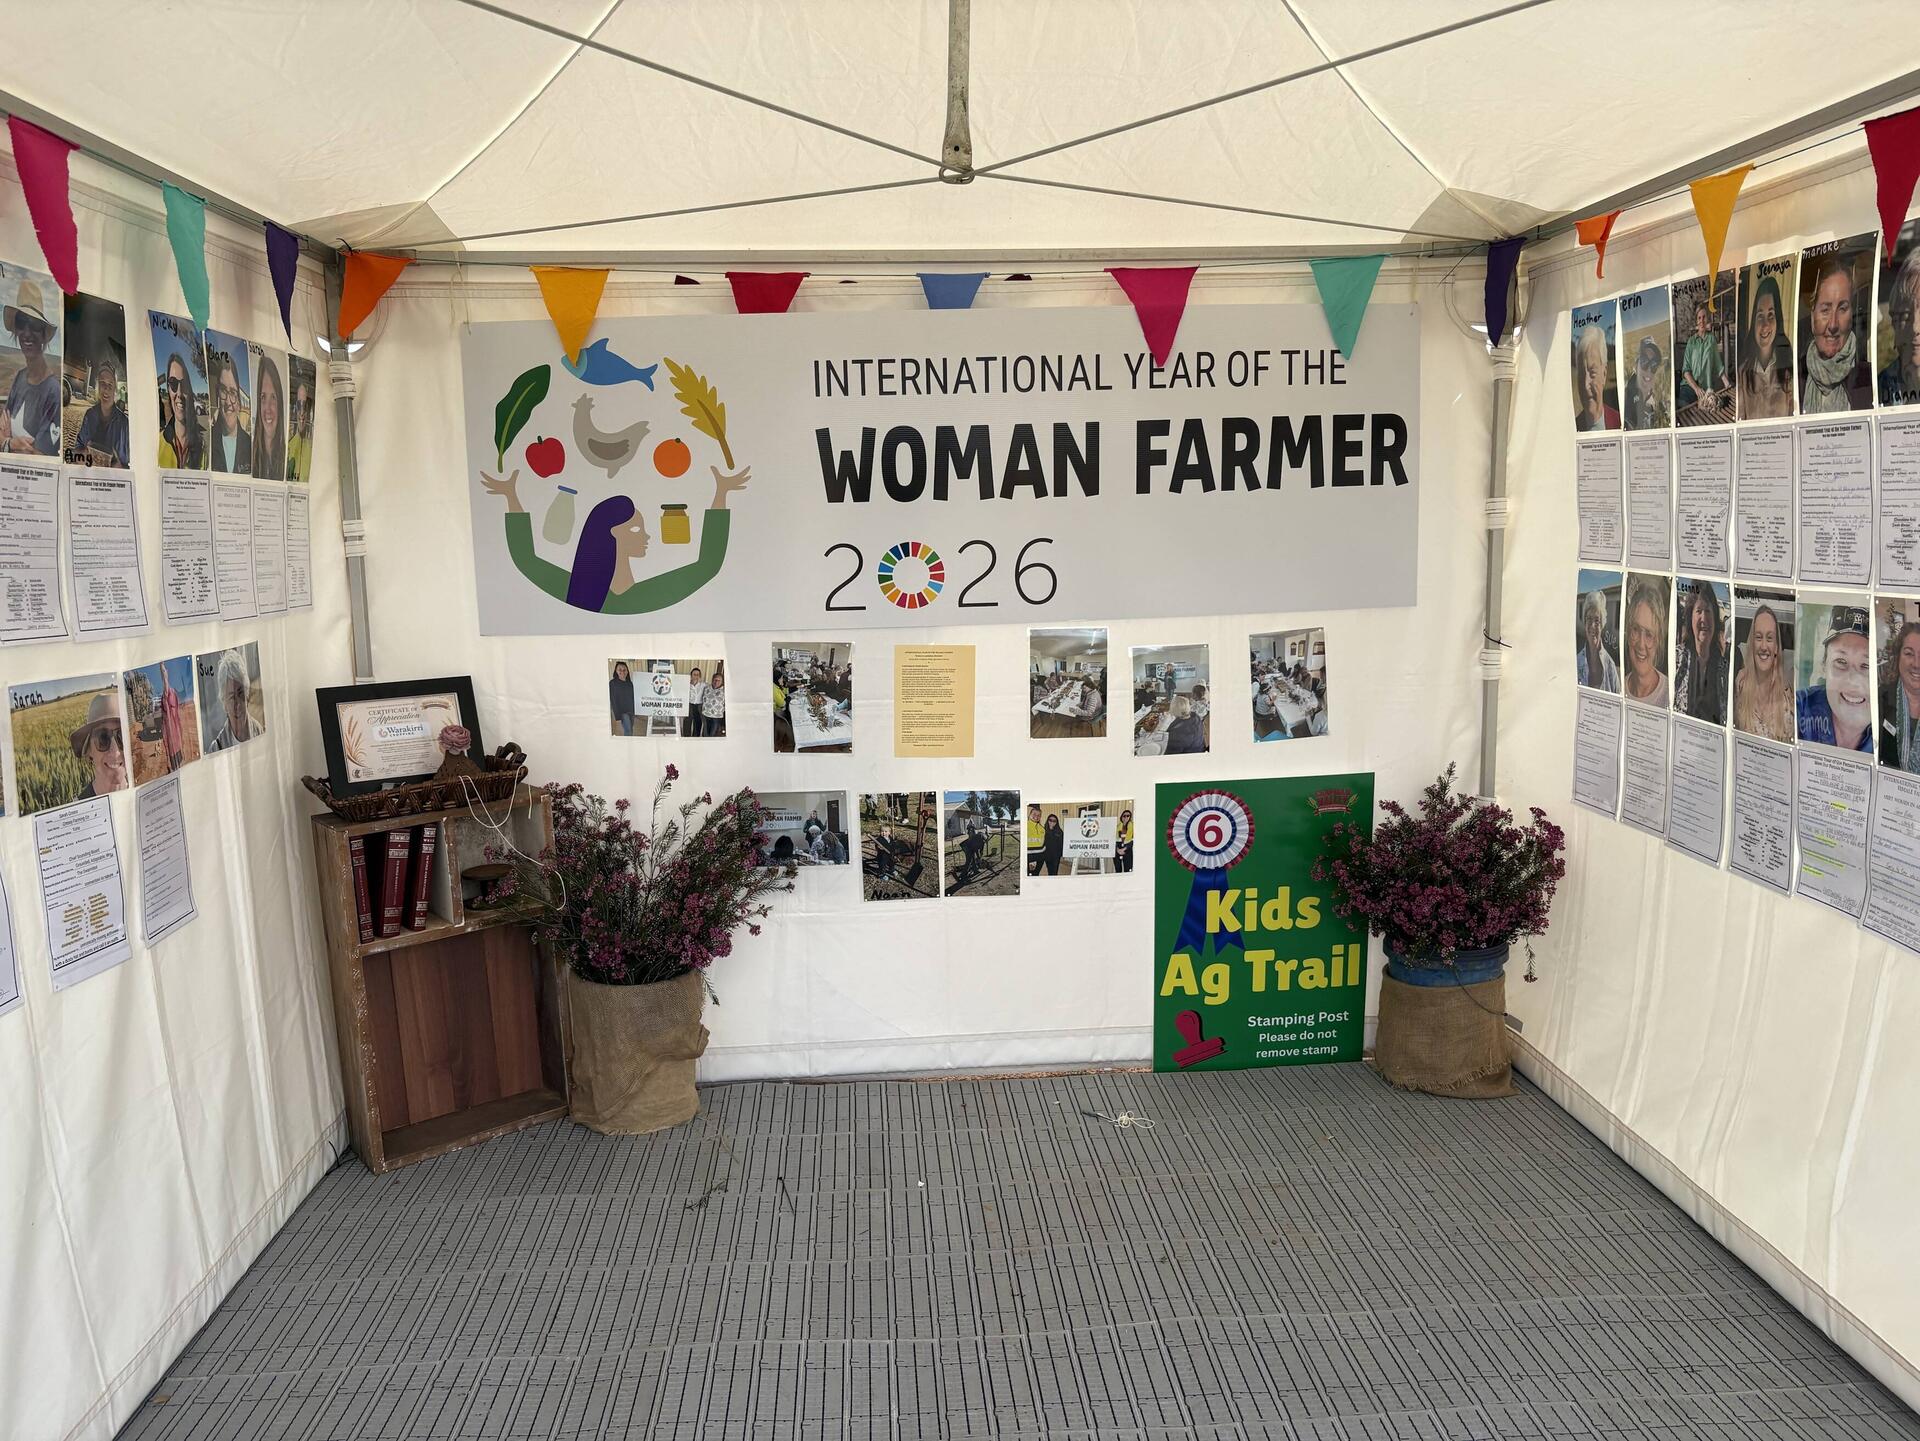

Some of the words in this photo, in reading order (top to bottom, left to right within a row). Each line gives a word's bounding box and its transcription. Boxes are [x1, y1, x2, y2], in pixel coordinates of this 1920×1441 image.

[1622, 294, 1642, 311] erin
[152, 316, 178, 337] Nicky
[1573, 312, 1603, 328] Heather
[208, 343, 230, 363] Clare
[812, 353, 1113, 397] INTERNATIONAL
[1124, 352, 1217, 391] YEAR
[1227, 350, 1270, 387] OF
[1280, 349, 1347, 386] THE
[65, 448, 93, 467] Amy
[815, 421, 1101, 503] WOMAN
[1136, 413, 1410, 494] FARMER
[824, 537, 1058, 611] 2026
[200, 663, 215, 677] Sue
[13, 690, 45, 709] Sarah
[367, 712, 420, 725] Appreciation
[368, 707, 408, 716] CERTIFICATE
[386, 724, 424, 734] Warakirri
[1800, 715, 1831, 735] emma
[1197, 813, 1224, 848] 6
[1206, 886, 1321, 934] Kids
[1159, 953, 1231, 1005] Ag
[1243, 944, 1361, 993] Trail
[1247, 1013, 1316, 1028] Stamping
[1318, 1010, 1350, 1024] Post
[1258, 1030, 1298, 1043] Please
[1299, 1029, 1315, 1041] do
[1317, 1028, 1338, 1040] not
[1255, 1047, 1301, 1059] remove
[1302, 1045, 1339, 1057] stamp
